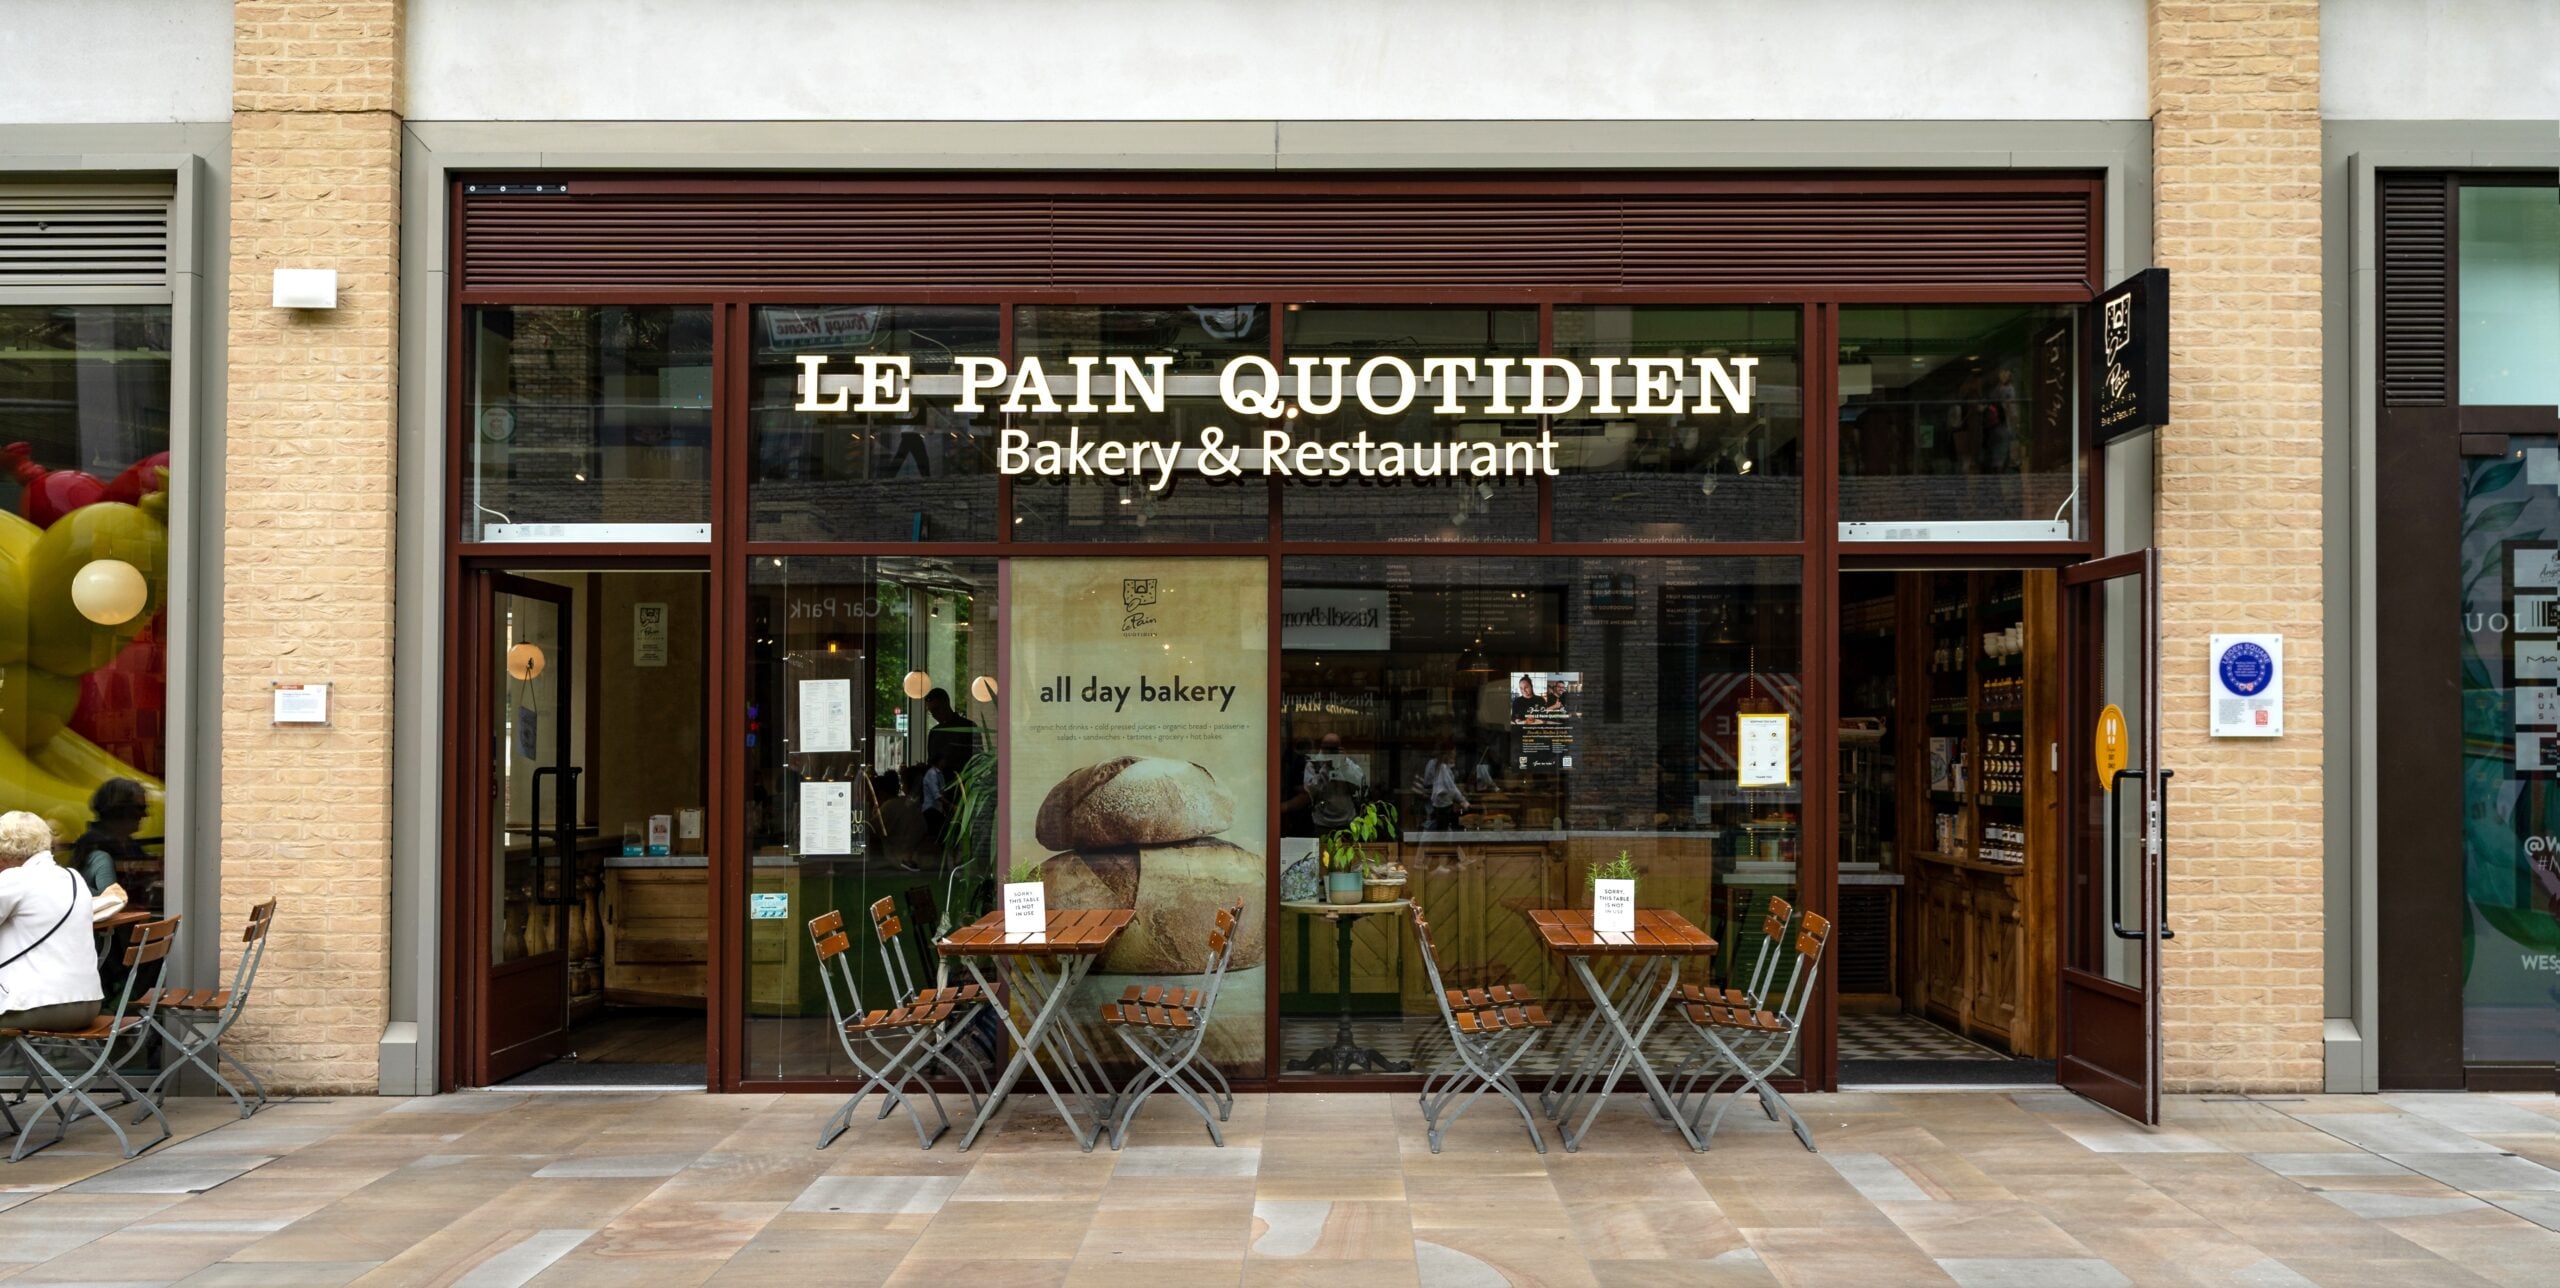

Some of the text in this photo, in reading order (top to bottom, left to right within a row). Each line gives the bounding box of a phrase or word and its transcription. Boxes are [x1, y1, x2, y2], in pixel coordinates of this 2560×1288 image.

[795, 355, 1759, 420] LE PAIN QUOTIDIEN
[1000, 426, 1560, 492] Bakery & Restaurant
[1040, 676, 1236, 712] all day bakery
